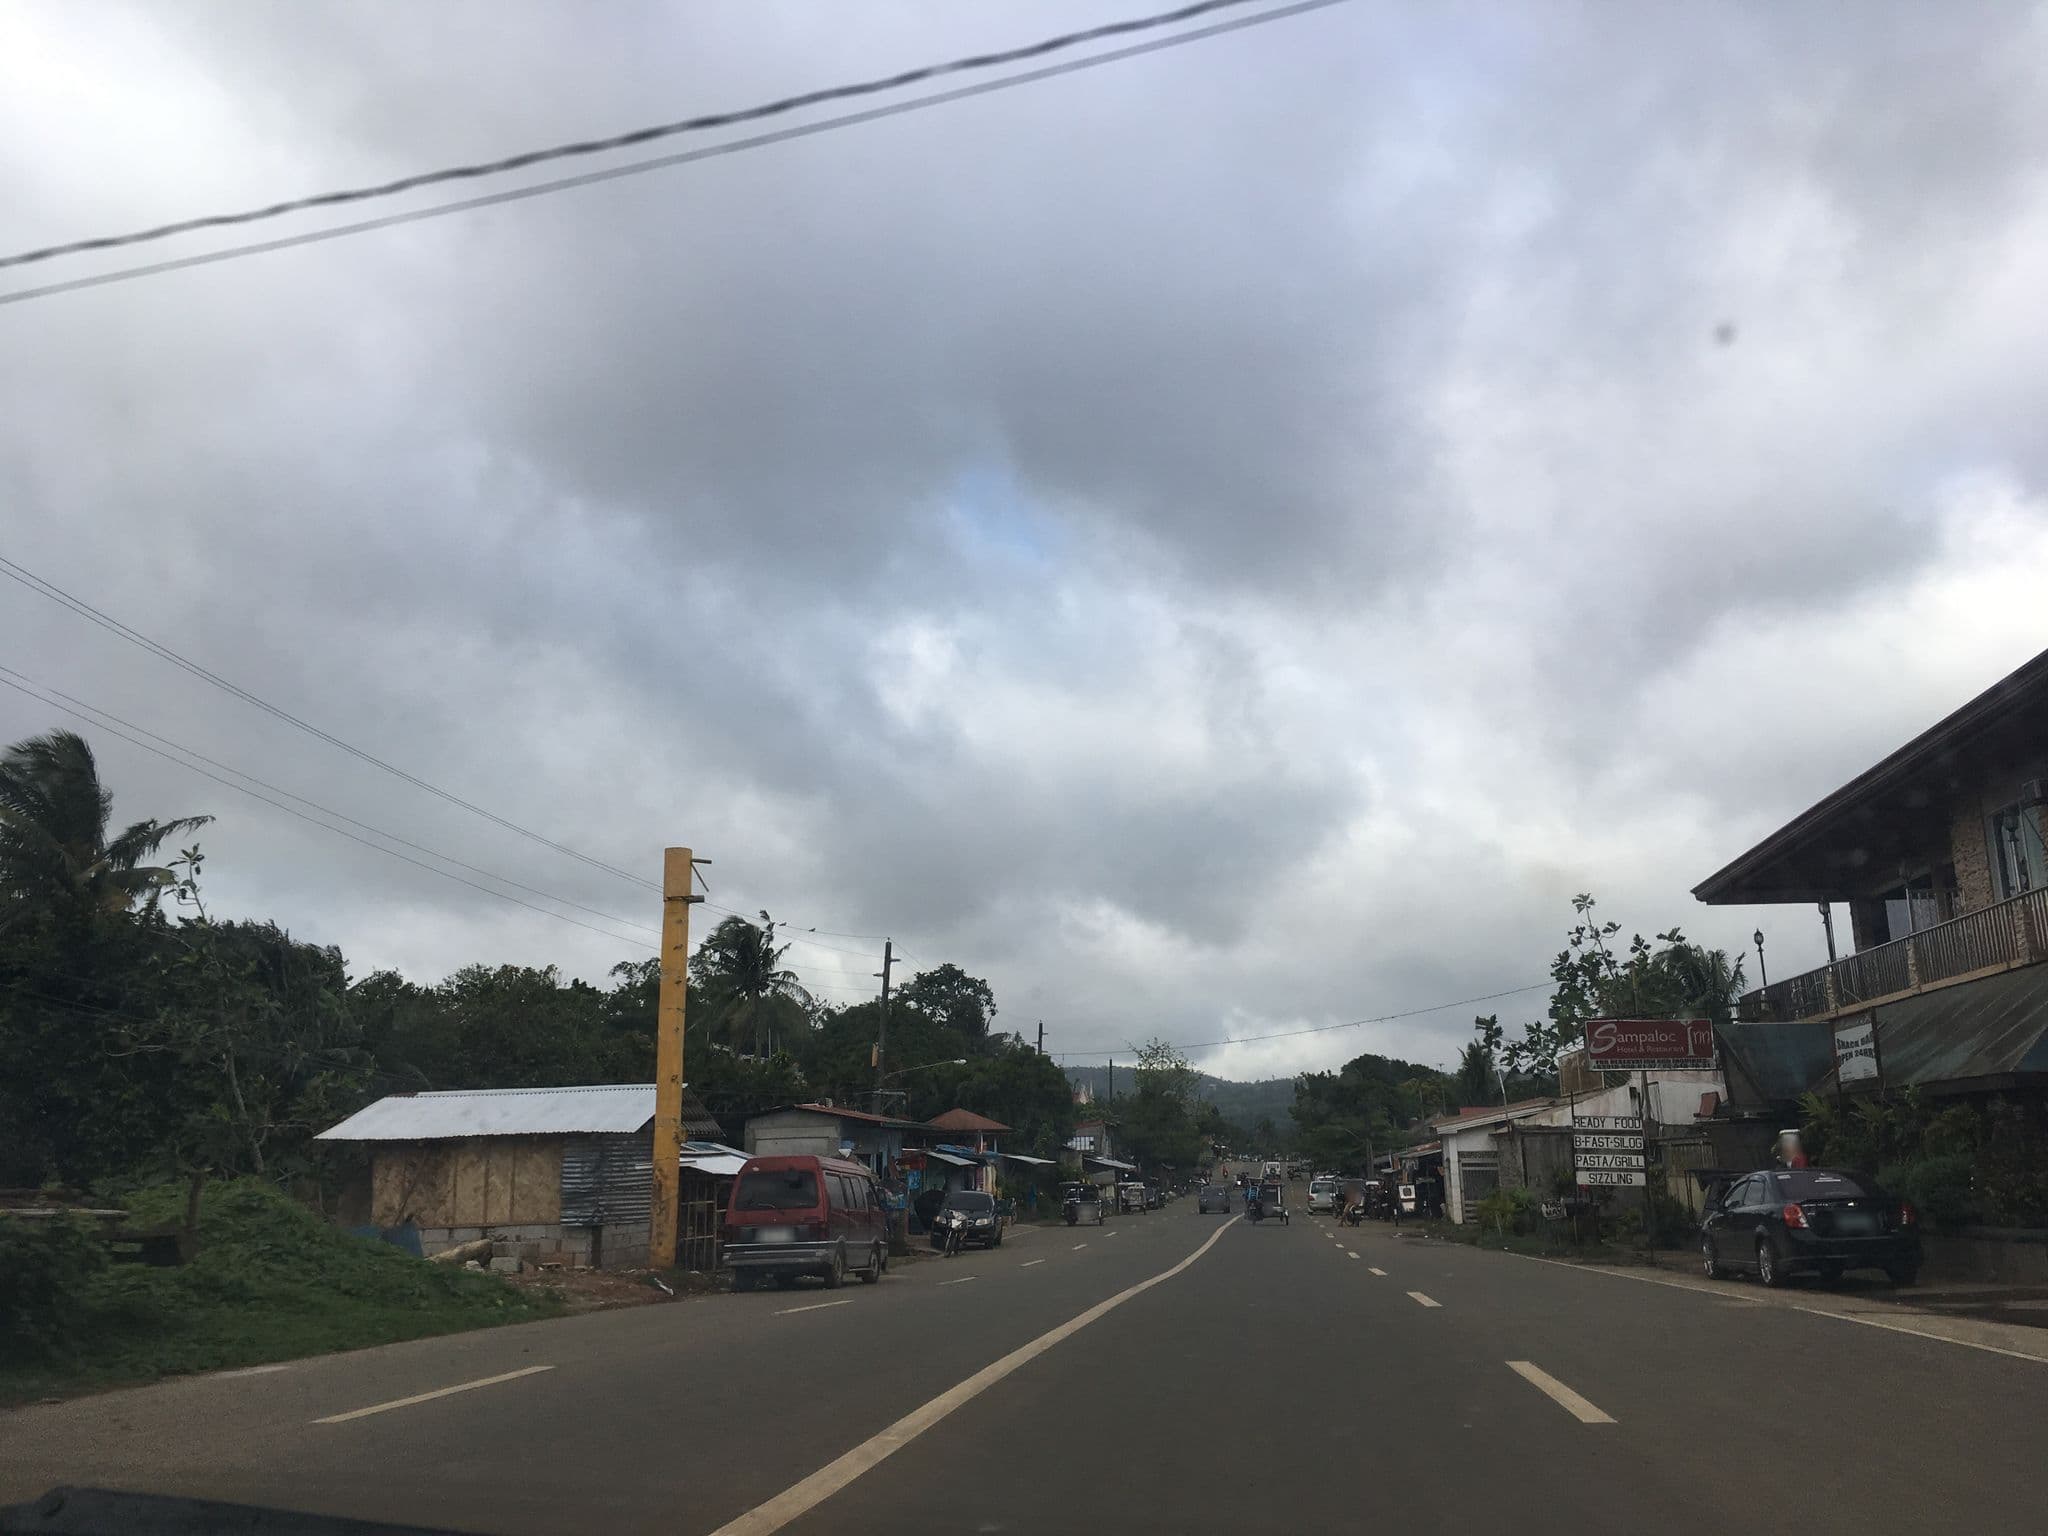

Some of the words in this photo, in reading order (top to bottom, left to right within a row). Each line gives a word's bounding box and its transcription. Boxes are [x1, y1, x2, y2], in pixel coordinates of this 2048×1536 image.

[1590, 1024, 1677, 1053] Sampaloc
[1574, 1117, 1606, 1129] READY
[1614, 1118, 1641, 1129] FOOD
[1574, 1137, 1643, 1148] B-FAST-SILOG
[1575, 1155, 1644, 1168] PASTA/GRILL
[1588, 1173, 1633, 1184] SIZZLING
